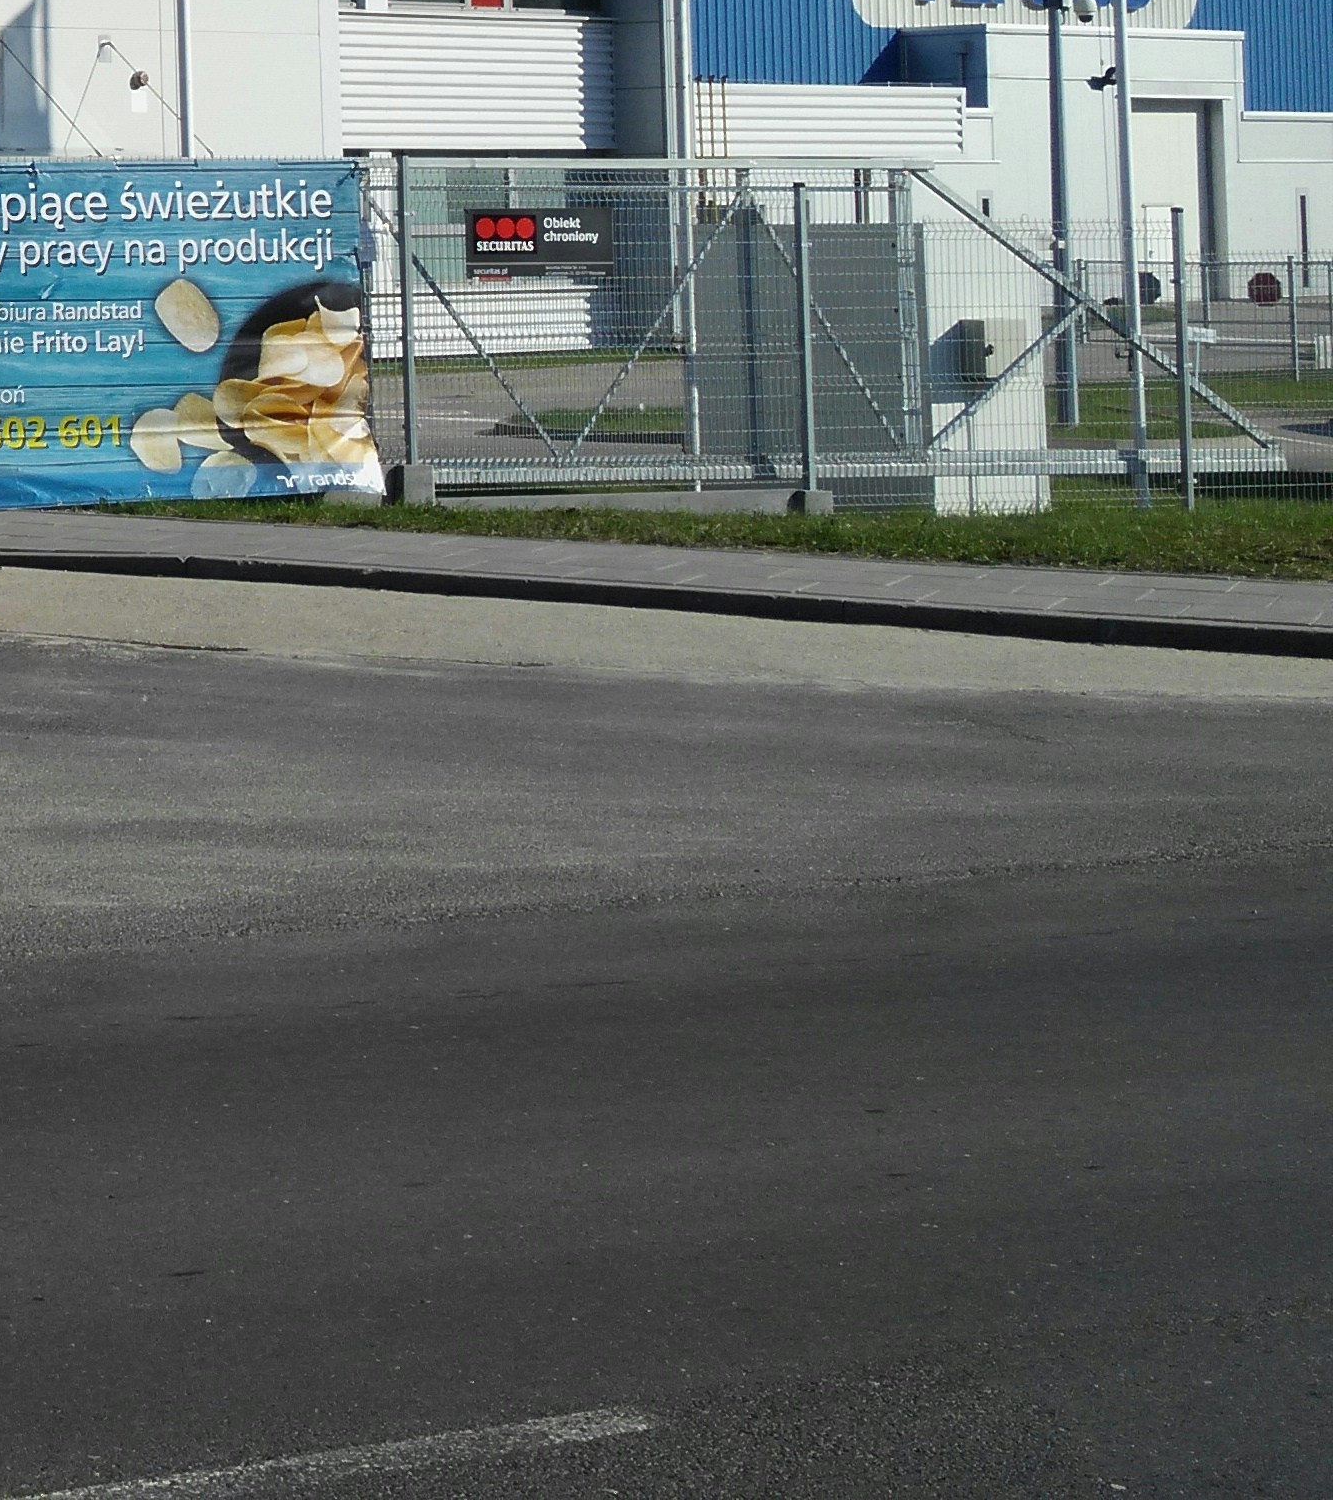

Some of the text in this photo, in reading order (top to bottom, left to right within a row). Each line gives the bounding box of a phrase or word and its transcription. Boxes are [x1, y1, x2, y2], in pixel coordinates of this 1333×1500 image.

[120, 178, 333, 221] świeżutkie
[543, 217, 582, 229] Obiekt
[476, 240, 535, 252] SECURITAS
[543, 230, 600, 245] chroniony
[19, 239, 114, 275] pracy
[124, 238, 167, 265] na
[179, 228, 333, 272] produkcji
[52, 300, 143, 321] Randstad
[32, 329, 88, 354] Frito
[95, 329, 145, 359] Lay!
[58, 414, 122, 449] 601
